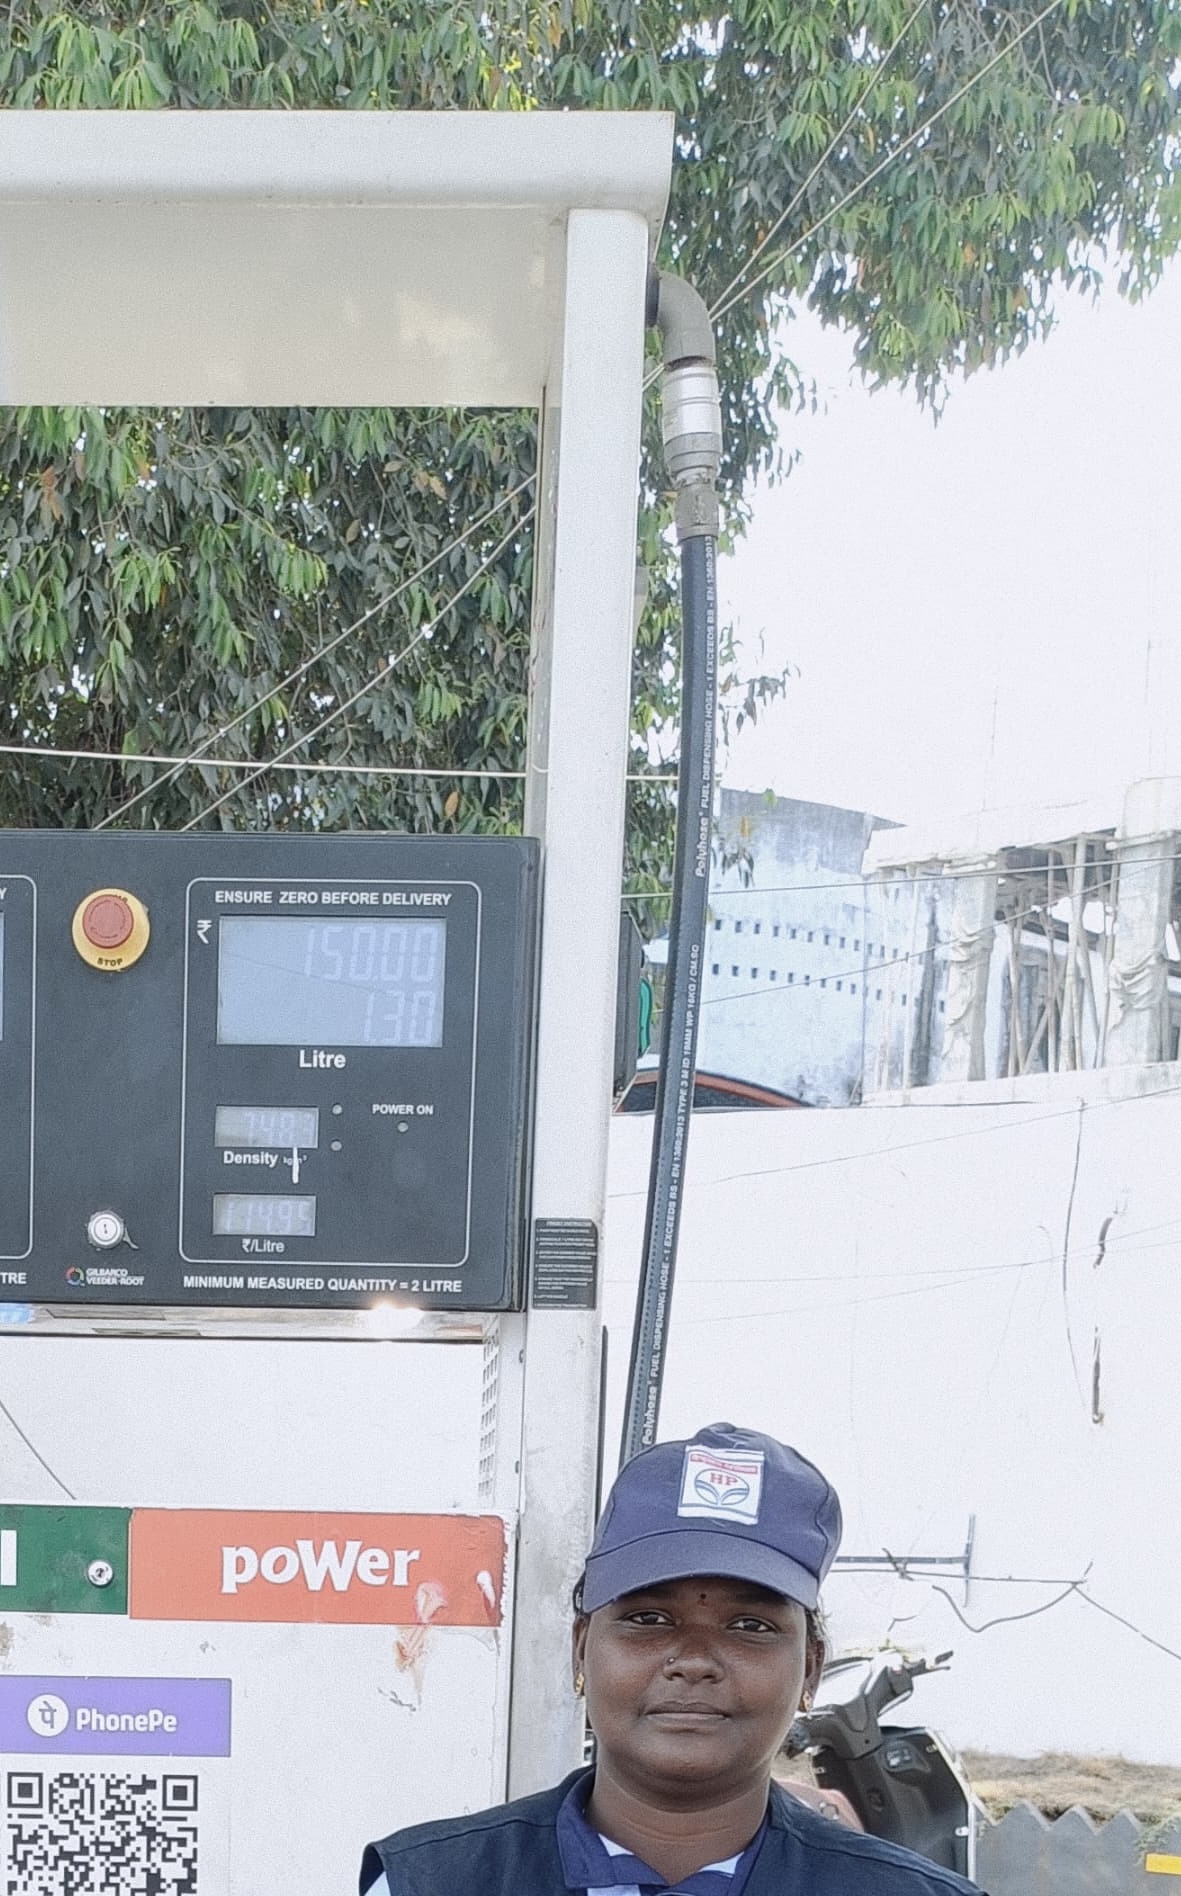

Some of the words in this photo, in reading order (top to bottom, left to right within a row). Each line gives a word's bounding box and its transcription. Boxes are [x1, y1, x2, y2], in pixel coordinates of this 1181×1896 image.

[705, 690, 713, 718] HOSE
[701, 783, 710, 808] FUEL
[215, 891, 272, 904] ENSURE
[279, 892, 318, 905] ZERO
[321, 892, 379, 906] BEFORE
[382, 893, 452, 907] DELIVERY
[196, 920, 212, 944] ₹
[97, 957, 123, 967] STOP
[299, 1049, 346, 1069] Litre
[372, 1104, 411, 1115] POWER
[415, 1104, 434, 1115] ON
[223, 1150, 278, 1168] Density
[241, 1238, 285, 1253] ₹/Litre
[183, 1276, 244, 1290] MINIMUM
[247, 1277, 324, 1291] MEASURED
[327, 1278, 397, 1292] QUANTITY
[411, 1279, 420, 1292] 2
[423, 1280, 462, 1293] LITRE
[660, 1262, 669, 1290] HOSE
[653, 1292, 666, 1350] DISPENSING
[651, 1352, 660, 1377] FUEL
[710, 1473, 738, 1486] HP
[75, 1708, 177, 1732] PhonePe
